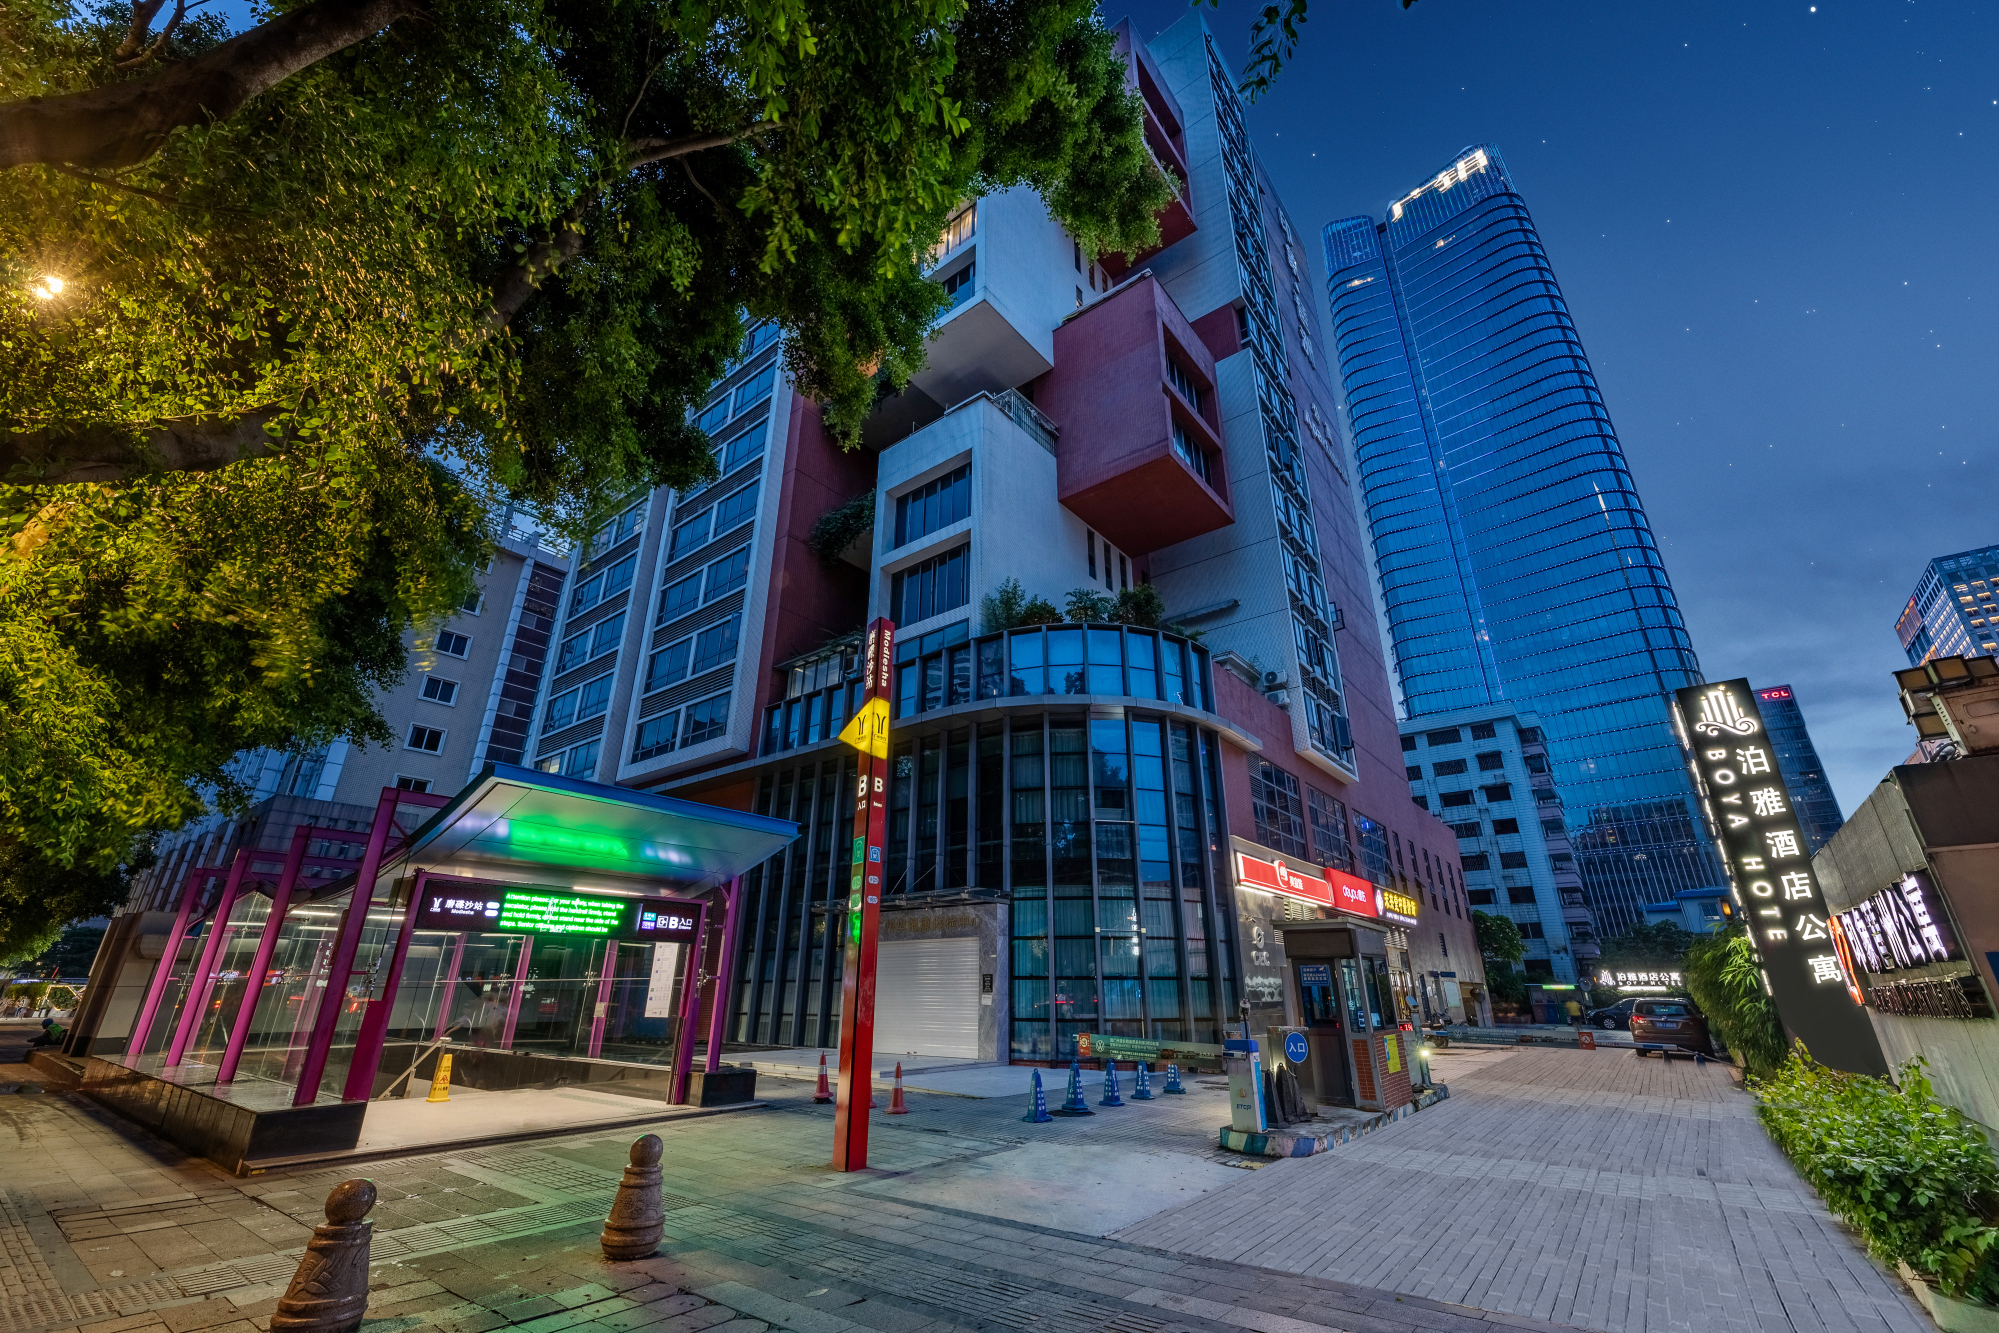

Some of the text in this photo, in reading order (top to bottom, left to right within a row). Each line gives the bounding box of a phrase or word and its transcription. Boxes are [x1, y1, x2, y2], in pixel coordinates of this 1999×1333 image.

[881, 630, 891, 687] Modiesha
[1760, 690, 1790, 700] TCL
[858, 775, 867, 797] B
[874, 777, 883, 793] B
[1706, 748, 1749, 829] BOYA
[1736, 745, 1842, 984] 泊雅酒店公寓
[669, 917, 678, 928] B
[680, 918, 693, 926] 入口
[1251, 951, 1270, 967] CEC
[1289, 1042, 1305, 1052] 入口
